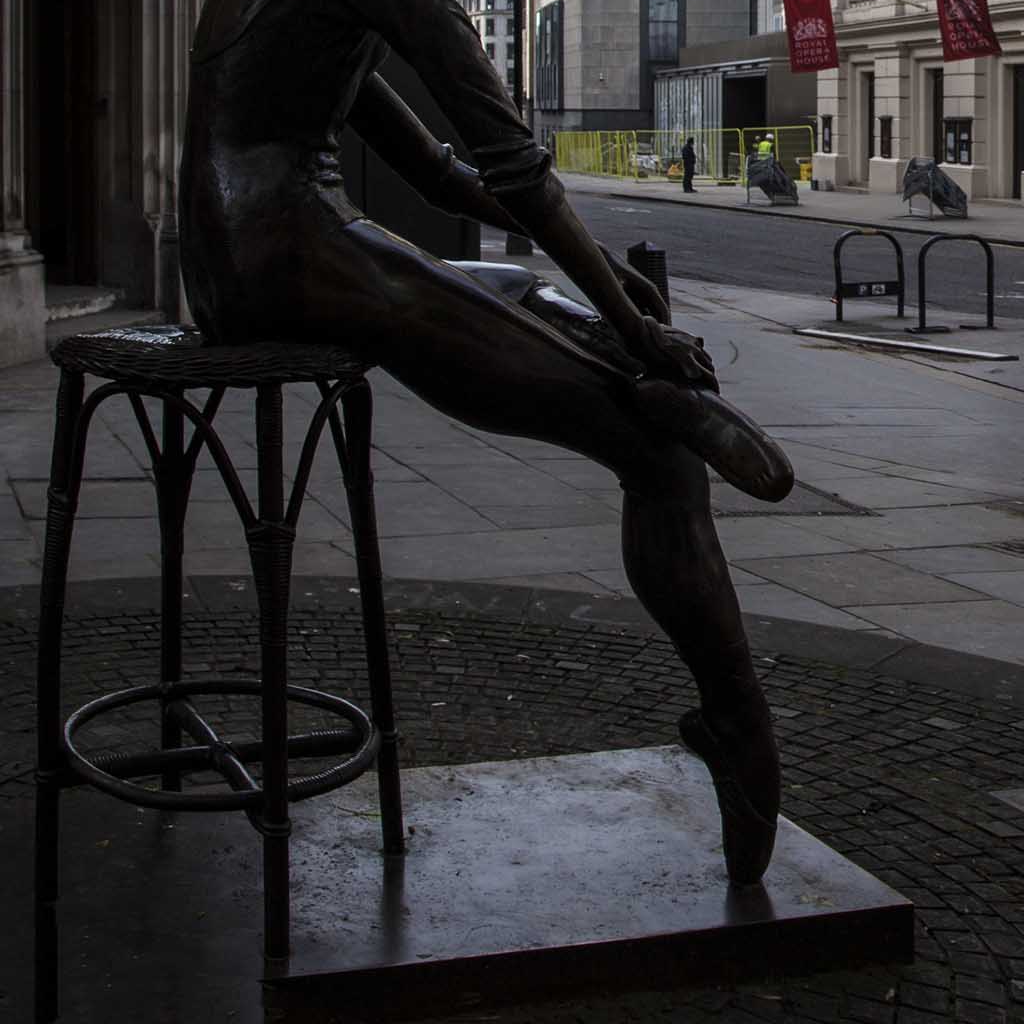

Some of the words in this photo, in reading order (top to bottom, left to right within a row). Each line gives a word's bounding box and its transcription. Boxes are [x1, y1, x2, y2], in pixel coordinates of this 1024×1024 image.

[794, 39, 831, 49] ROYAL
[794, 47, 831, 57] OPERA
[796, 54, 832, 65] HOUSE
